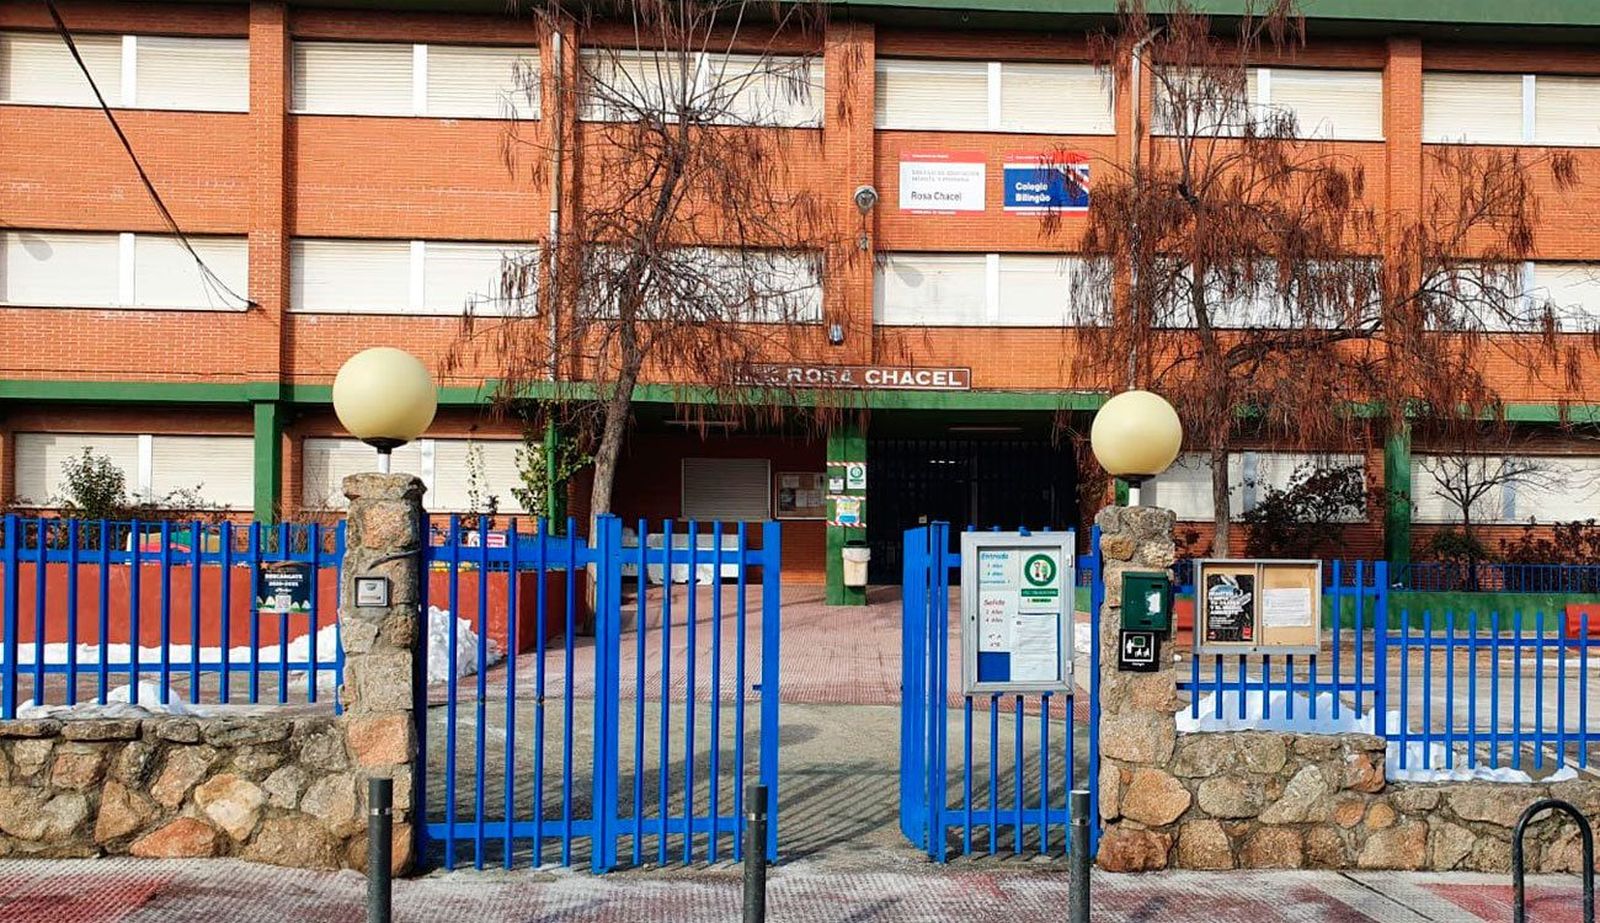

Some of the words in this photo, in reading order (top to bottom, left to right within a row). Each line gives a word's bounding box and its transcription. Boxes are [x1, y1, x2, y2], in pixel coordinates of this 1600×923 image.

[1015, 182, 1048, 193] Colegio
[911, 191, 932, 201] Rosa
[934, 191, 962, 202] Chacel
[787, 367, 852, 384] ROSA
[864, 369, 962, 386] CHACEL
[981, 552, 1009, 560] Entrada
